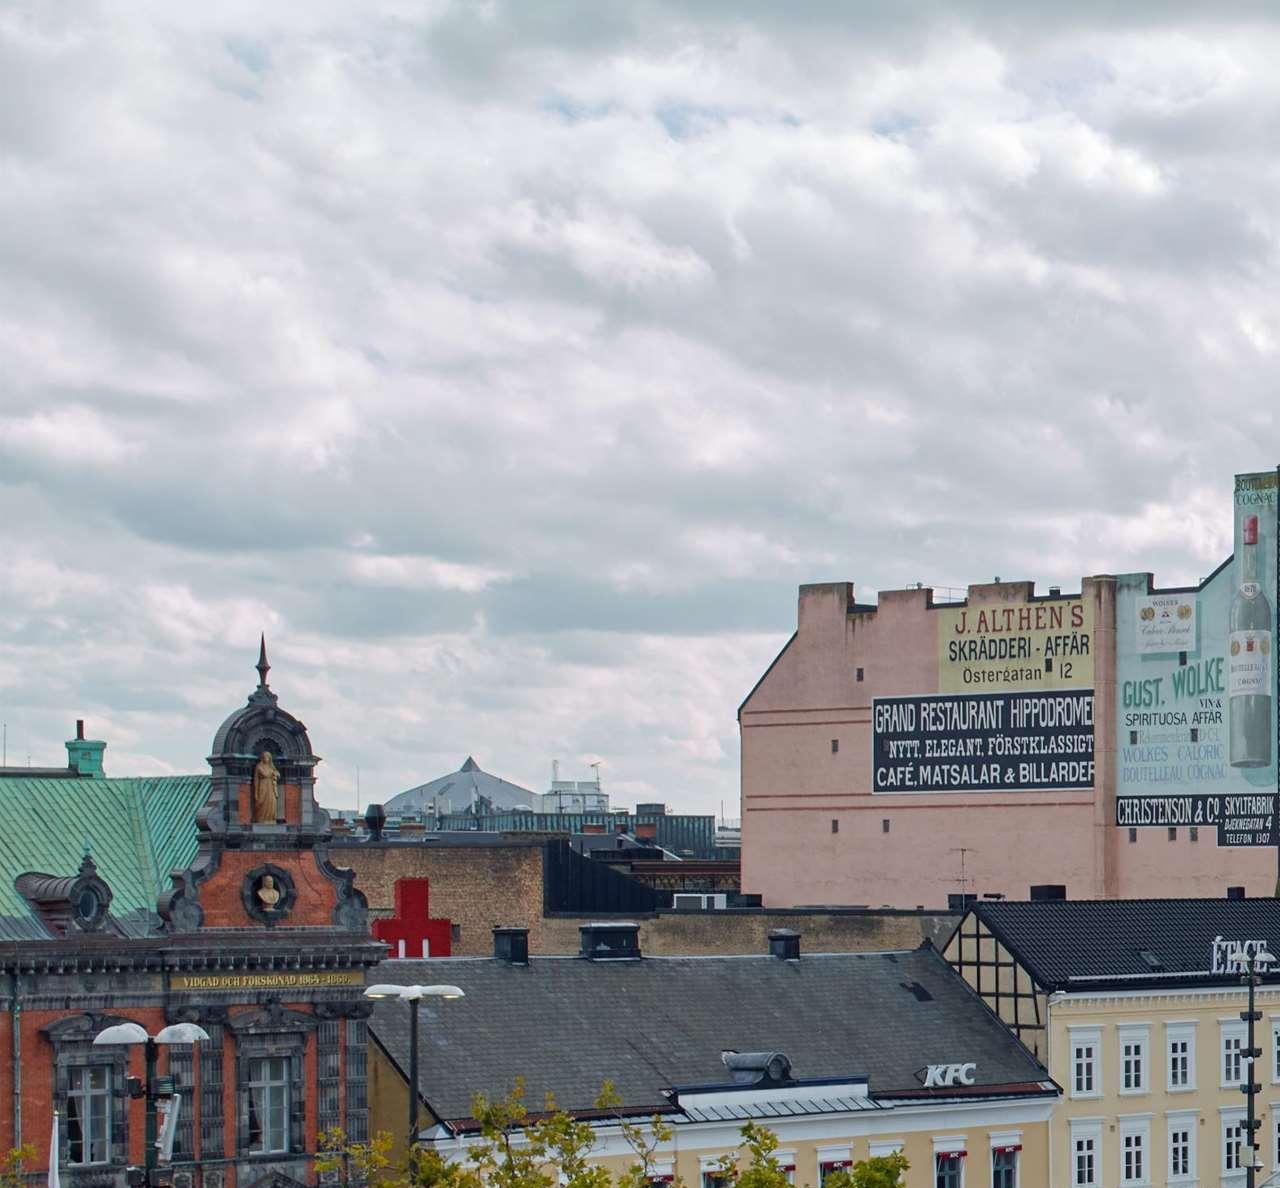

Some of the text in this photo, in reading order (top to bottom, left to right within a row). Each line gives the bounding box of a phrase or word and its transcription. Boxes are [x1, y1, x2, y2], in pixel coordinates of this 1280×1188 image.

[954, 600, 1084, 635] J. ALTHÉN'S
[948, 635, 1032, 662] SKRÄDDERI
[1044, 631, 1090, 657] AFFÄR
[1059, 662, 1073, 679] 12
[1122, 657, 1225, 709] GUST. WOLKE
[874, 696, 1095, 734] GRAND RESTAURANT HIPPODROME
[1125, 711, 1188, 727] SPIRITUOSA
[988, 734, 1094, 756] FÖRSTKLASSIGT
[876, 762, 918, 787] CAFÉ,
[919, 763, 1001, 786] MATSALAR
[1003, 768, 1016, 784] &
[1117, 797, 1193, 825] CHRISTENSON
[1193, 799, 1204, 824] &
[1224, 795, 1275, 816] SKYLTFABRIK
[1264, 815, 1273, 831] 4
[1225, 833, 1252, 845] TELEFON
[183, 976, 219, 988] VIDGAD
[221, 976, 240, 987] OCH
[923, 1062, 977, 1087] KFC
